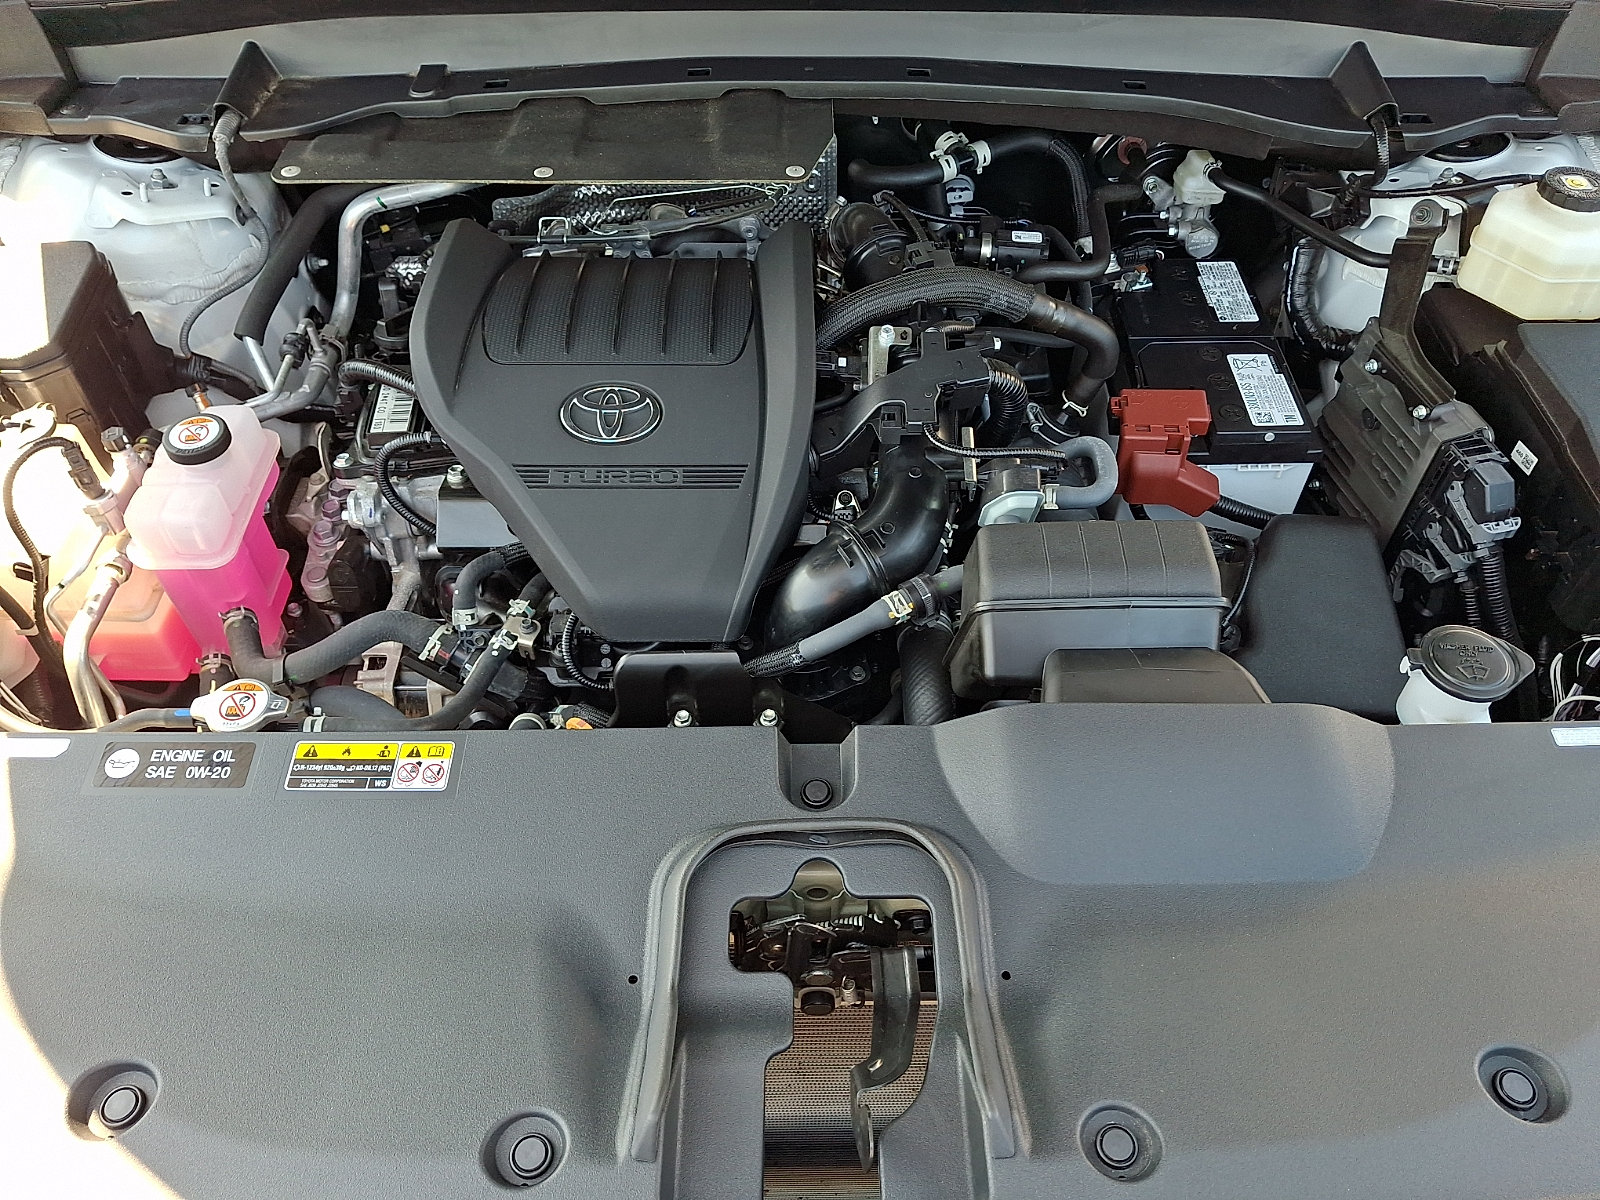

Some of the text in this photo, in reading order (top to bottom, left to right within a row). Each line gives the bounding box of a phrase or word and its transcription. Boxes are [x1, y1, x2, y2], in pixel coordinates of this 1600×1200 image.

[553, 468, 681, 484] TURBO
[150, 749, 236, 762] ENGINE OIL
[144, 766, 231, 779] SAE 0W-20
[374, 780, 387, 788] WS
